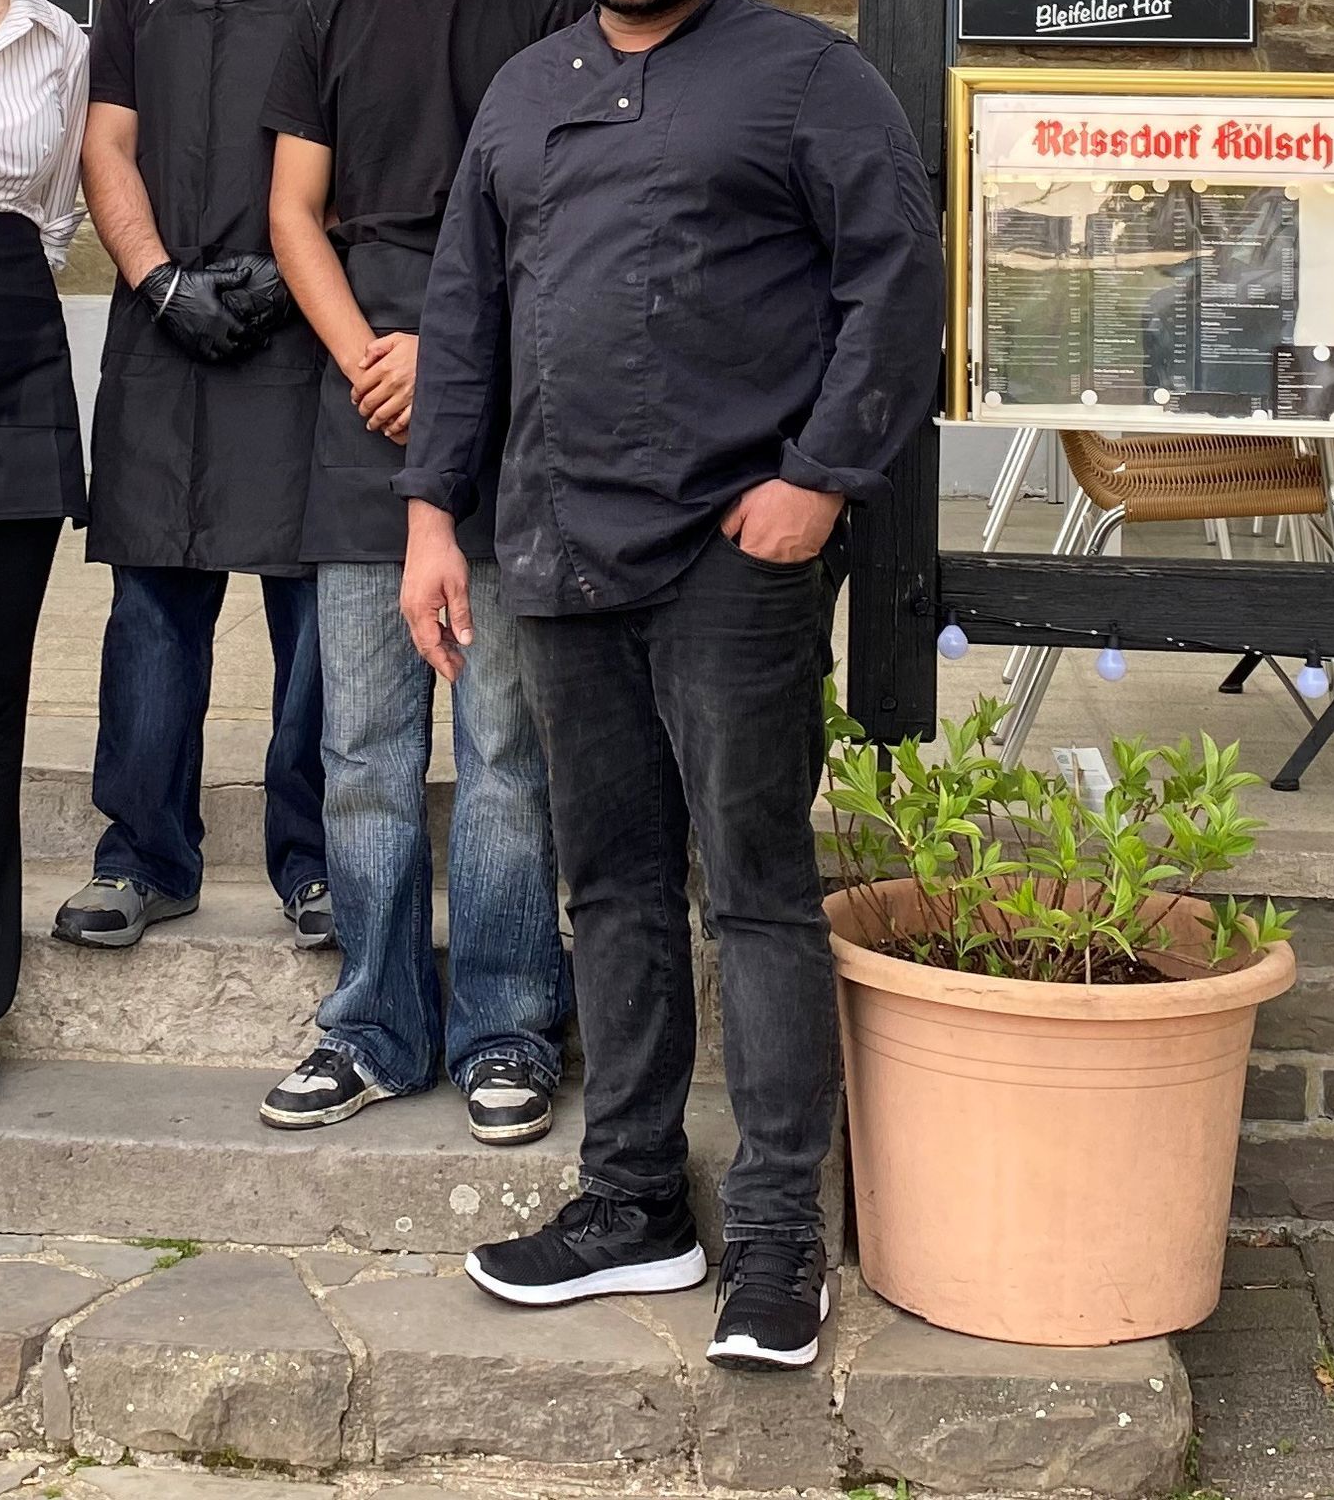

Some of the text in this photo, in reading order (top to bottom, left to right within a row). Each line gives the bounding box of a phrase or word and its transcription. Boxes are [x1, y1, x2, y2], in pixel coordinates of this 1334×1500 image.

[1035, 0, 1128, 28] Bleifelder
[1033, 119, 1334, 169] Reissdorf Kölsch
